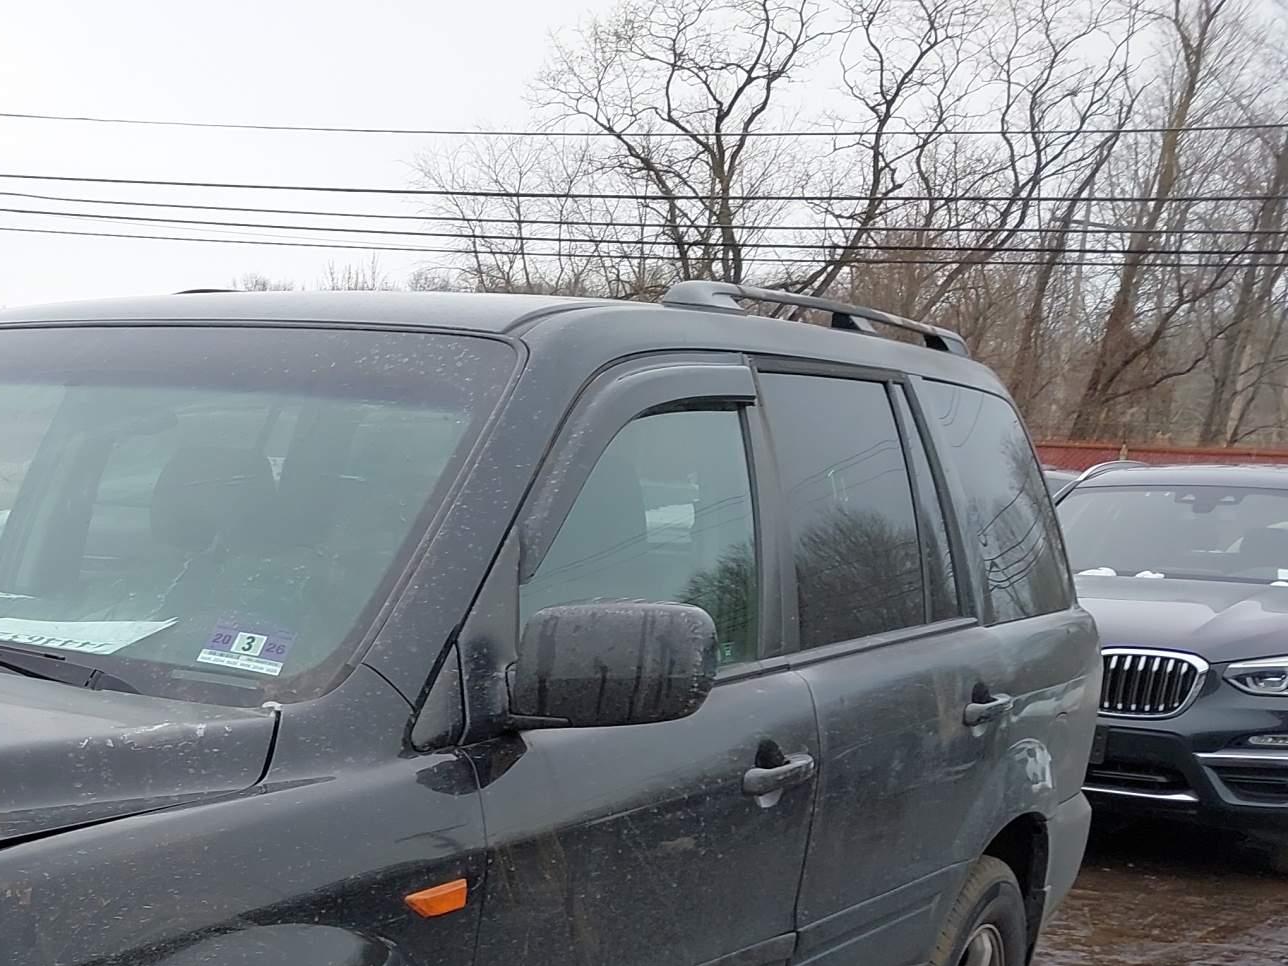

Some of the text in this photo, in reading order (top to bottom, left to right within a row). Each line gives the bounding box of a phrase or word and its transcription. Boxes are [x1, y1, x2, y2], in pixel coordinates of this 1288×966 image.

[213, 633, 286, 655] 20 3 26
